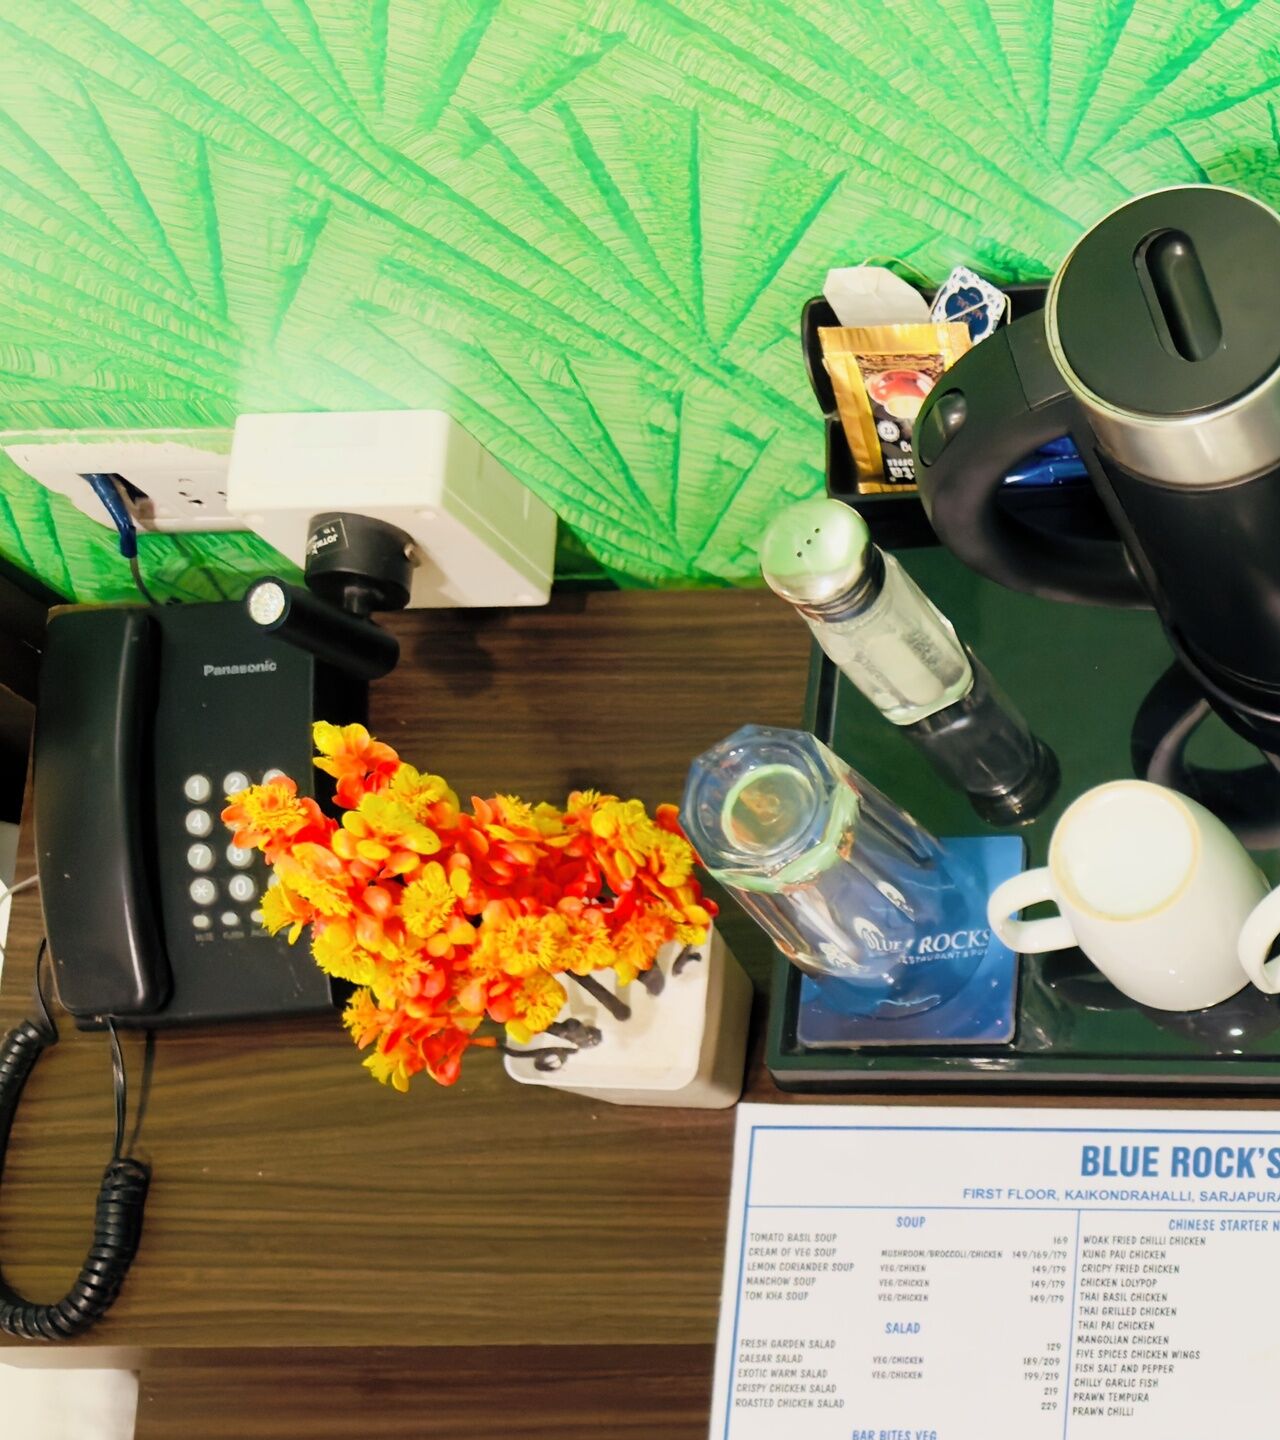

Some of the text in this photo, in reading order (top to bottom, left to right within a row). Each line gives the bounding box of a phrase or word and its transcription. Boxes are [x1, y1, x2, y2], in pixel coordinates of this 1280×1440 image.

[203, 661, 277, 677] Panasonic
[1080, 1145, 1160, 1178] BLUE
[963, 1188, 1003, 1200] FIRST
[1007, 1188, 1059, 1201] FLOOR,
[1065, 1190, 1195, 1202] KAIKONDRAHALLI,
[896, 1216, 926, 1228] SOUP
[1168, 1219, 1215, 1231] CHINESE
[1219, 1219, 1269, 1232] STARTER
[750, 1232, 837, 1243] TOMATO BASIL SOUP
[1082, 1249, 1106, 1259] KUNG
[1110, 1249, 1126, 1259] PAU
[1129, 1250, 1166, 1259] CHICKEN
[1080, 1291, 1099, 1301] THAI
[1103, 1292, 1127, 1302] BASIL
[1130, 1292, 1168, 1302] CHICKEN
[885, 1322, 921, 1334] SALAD
[1077, 1335, 1129, 1344] MANGOLIAN
[1132, 1335, 1169, 1345] CHICKEN
[1073, 1392, 1104, 1401] PRAWN
[1108, 1392, 1149, 1402] TEMPURA
[735, 1398, 845, 1408] ROASTED CHICKEN SALAD
